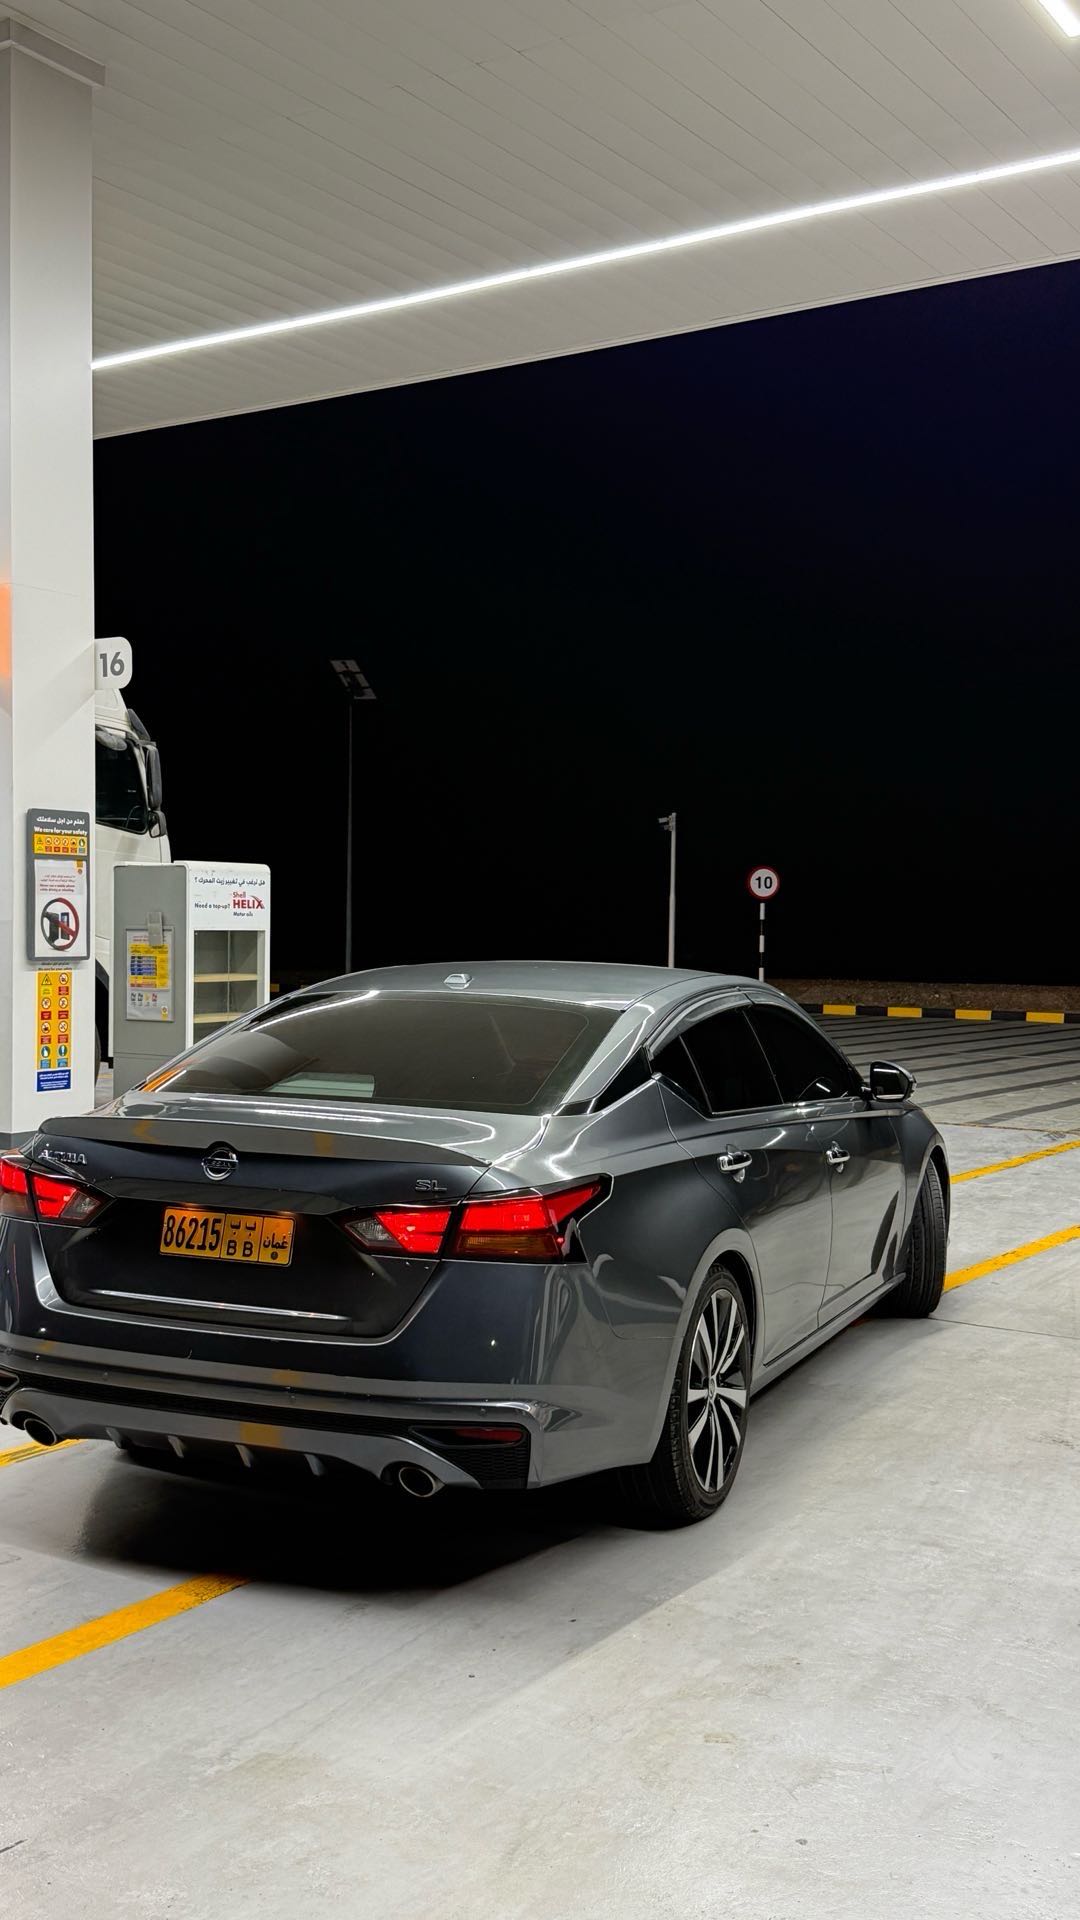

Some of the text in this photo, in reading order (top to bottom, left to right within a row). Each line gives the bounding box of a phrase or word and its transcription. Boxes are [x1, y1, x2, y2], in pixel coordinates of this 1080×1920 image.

[99, 651, 125, 678] 16
[72, 828, 88, 837] safety
[238, 879, 245, 887] في
[755, 876, 773, 889] 10
[212, 902, 230, 910] top-up?
[233, 899, 265, 909] HELIX
[415, 1179, 448, 1191] SL
[163, 1214, 222, 1251] 86215
